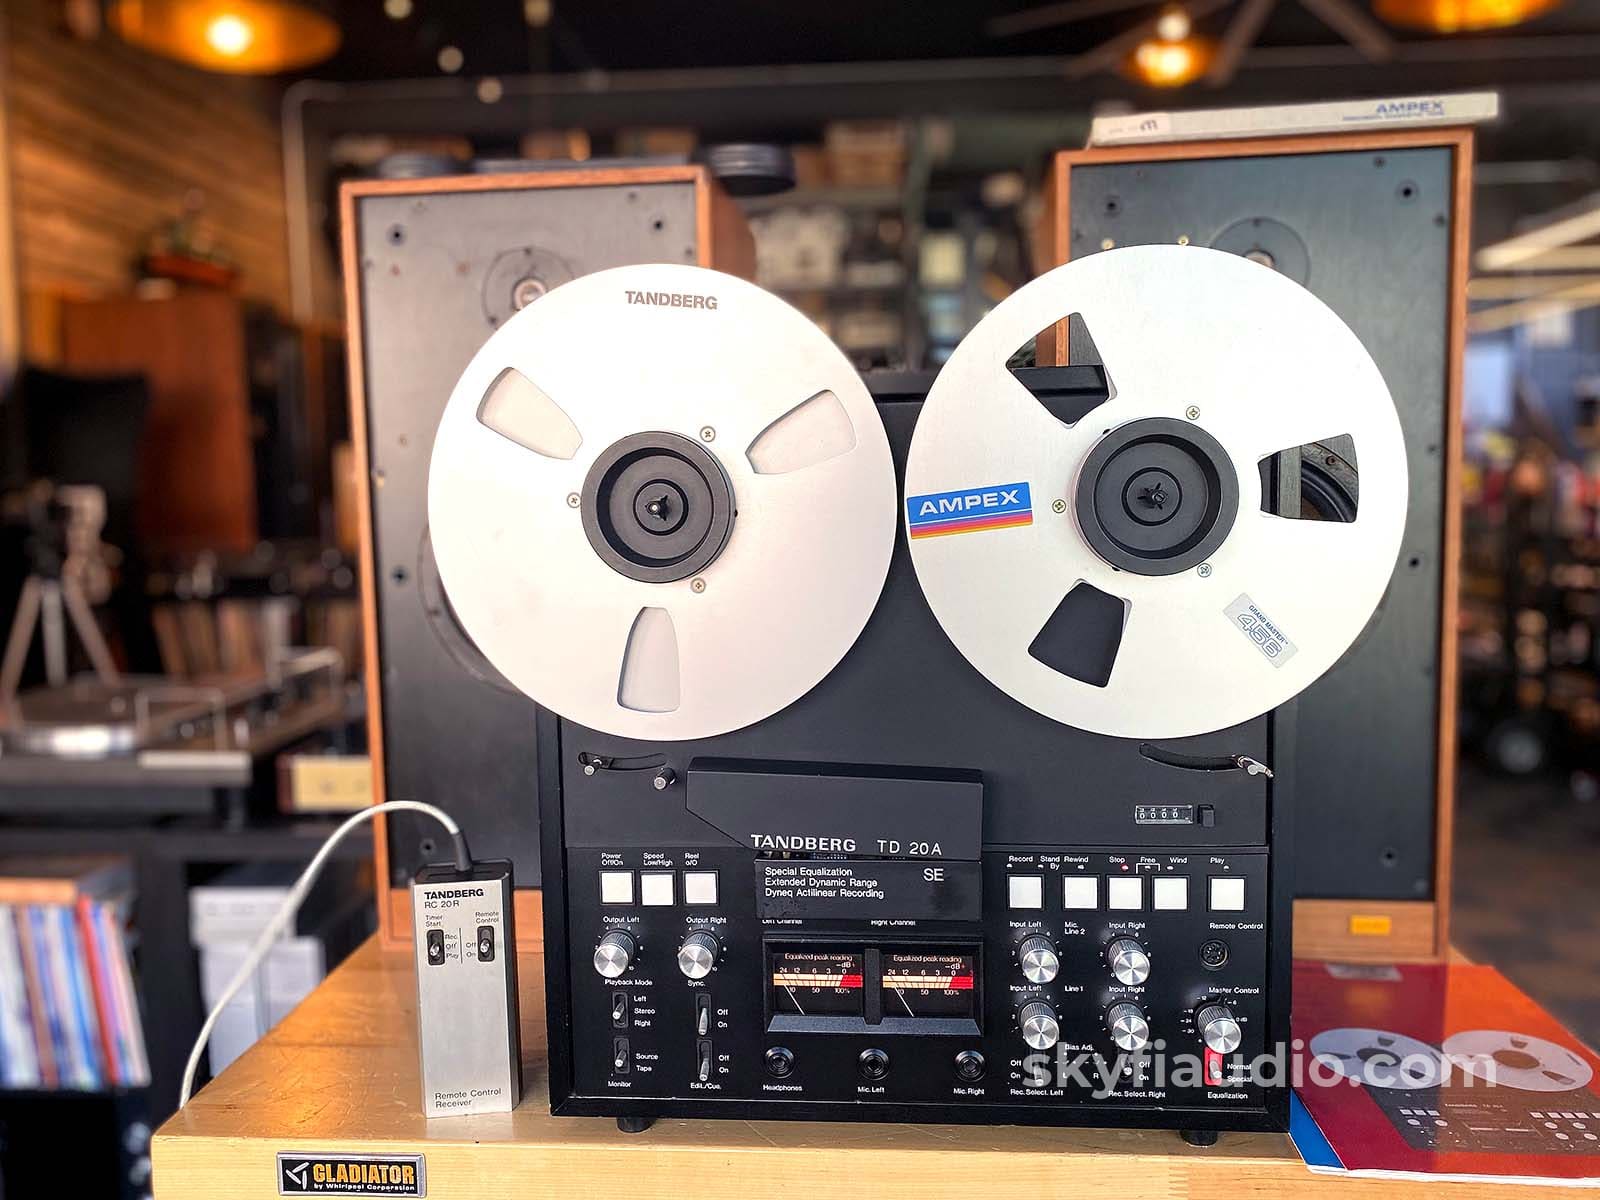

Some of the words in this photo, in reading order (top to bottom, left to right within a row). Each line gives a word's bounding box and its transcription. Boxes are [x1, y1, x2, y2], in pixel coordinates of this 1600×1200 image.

[1376, 101, 1444, 113] AMPEX
[625, 290, 718, 310] TANDBERG
[919, 488, 1020, 516] AMPEX
[1248, 604, 1267, 624] GRAND
[1237, 613, 1282, 658] 456
[751, 834, 856, 852] TANDBERG
[877, 840, 900, 853] TD
[601, 852, 622, 860] Power
[643, 852, 665, 860] Speed
[684, 852, 700, 860] Reel
[1008, 855, 1034, 863] Record
[1040, 855, 1061, 863] Stand
[1064, 855, 1089, 864] Rewind
[1109, 856, 1126, 865] Stop
[1140, 856, 1156, 864] Free
[1169, 856, 1188, 864] Wind
[1210, 857, 1225, 866] Play
[1050, 862, 1060, 871] By
[765, 867, 798, 878] Special
[800, 867, 853, 878] Equalization
[923, 868, 944, 882] SE
[765, 878, 806, 887] Extended
[809, 878, 846, 889] Dynamic
[850, 879, 878, 889] Range
[424, 888, 485, 900] TANDBERG
[765, 888, 793, 898] Dyneq
[796, 888, 837, 897] Actilinear
[840, 889, 884, 900] Recording
[424, 901, 437, 909] RC
[603, 916, 625, 924] Output
[627, 915, 640, 923] Left
[686, 916, 708, 924] Output
[710, 916, 727, 925] Right
[1209, 922, 1235, 930] Remote
[1237, 922, 1263, 930] Control
[604, 978, 633, 987] Playback
[1234, 986, 1260, 994] Control
[717, 1008, 729, 1016] Off
[1064, 1043, 1079, 1051] Bias
[718, 1054, 730, 1062] Off
[1010, 1059, 1021, 1067] Off
[762, 1083, 803, 1093] Headphones
[871, 1085, 885, 1093] Left
[967, 1087, 985, 1096] Right
[434, 1090, 468, 1100] Remote
[470, 1087, 502, 1097] Control
[1148, 1091, 1166, 1099] Right
[1207, 1091, 1249, 1100] Equalization
[435, 1098, 472, 1109] Receiver
[313, 1163, 415, 1185] GLADIATOR
[313, 1183, 323, 1191] by
[325, 1183, 365, 1192] Whirlpool
[366, 1184, 415, 1192] Corporation
